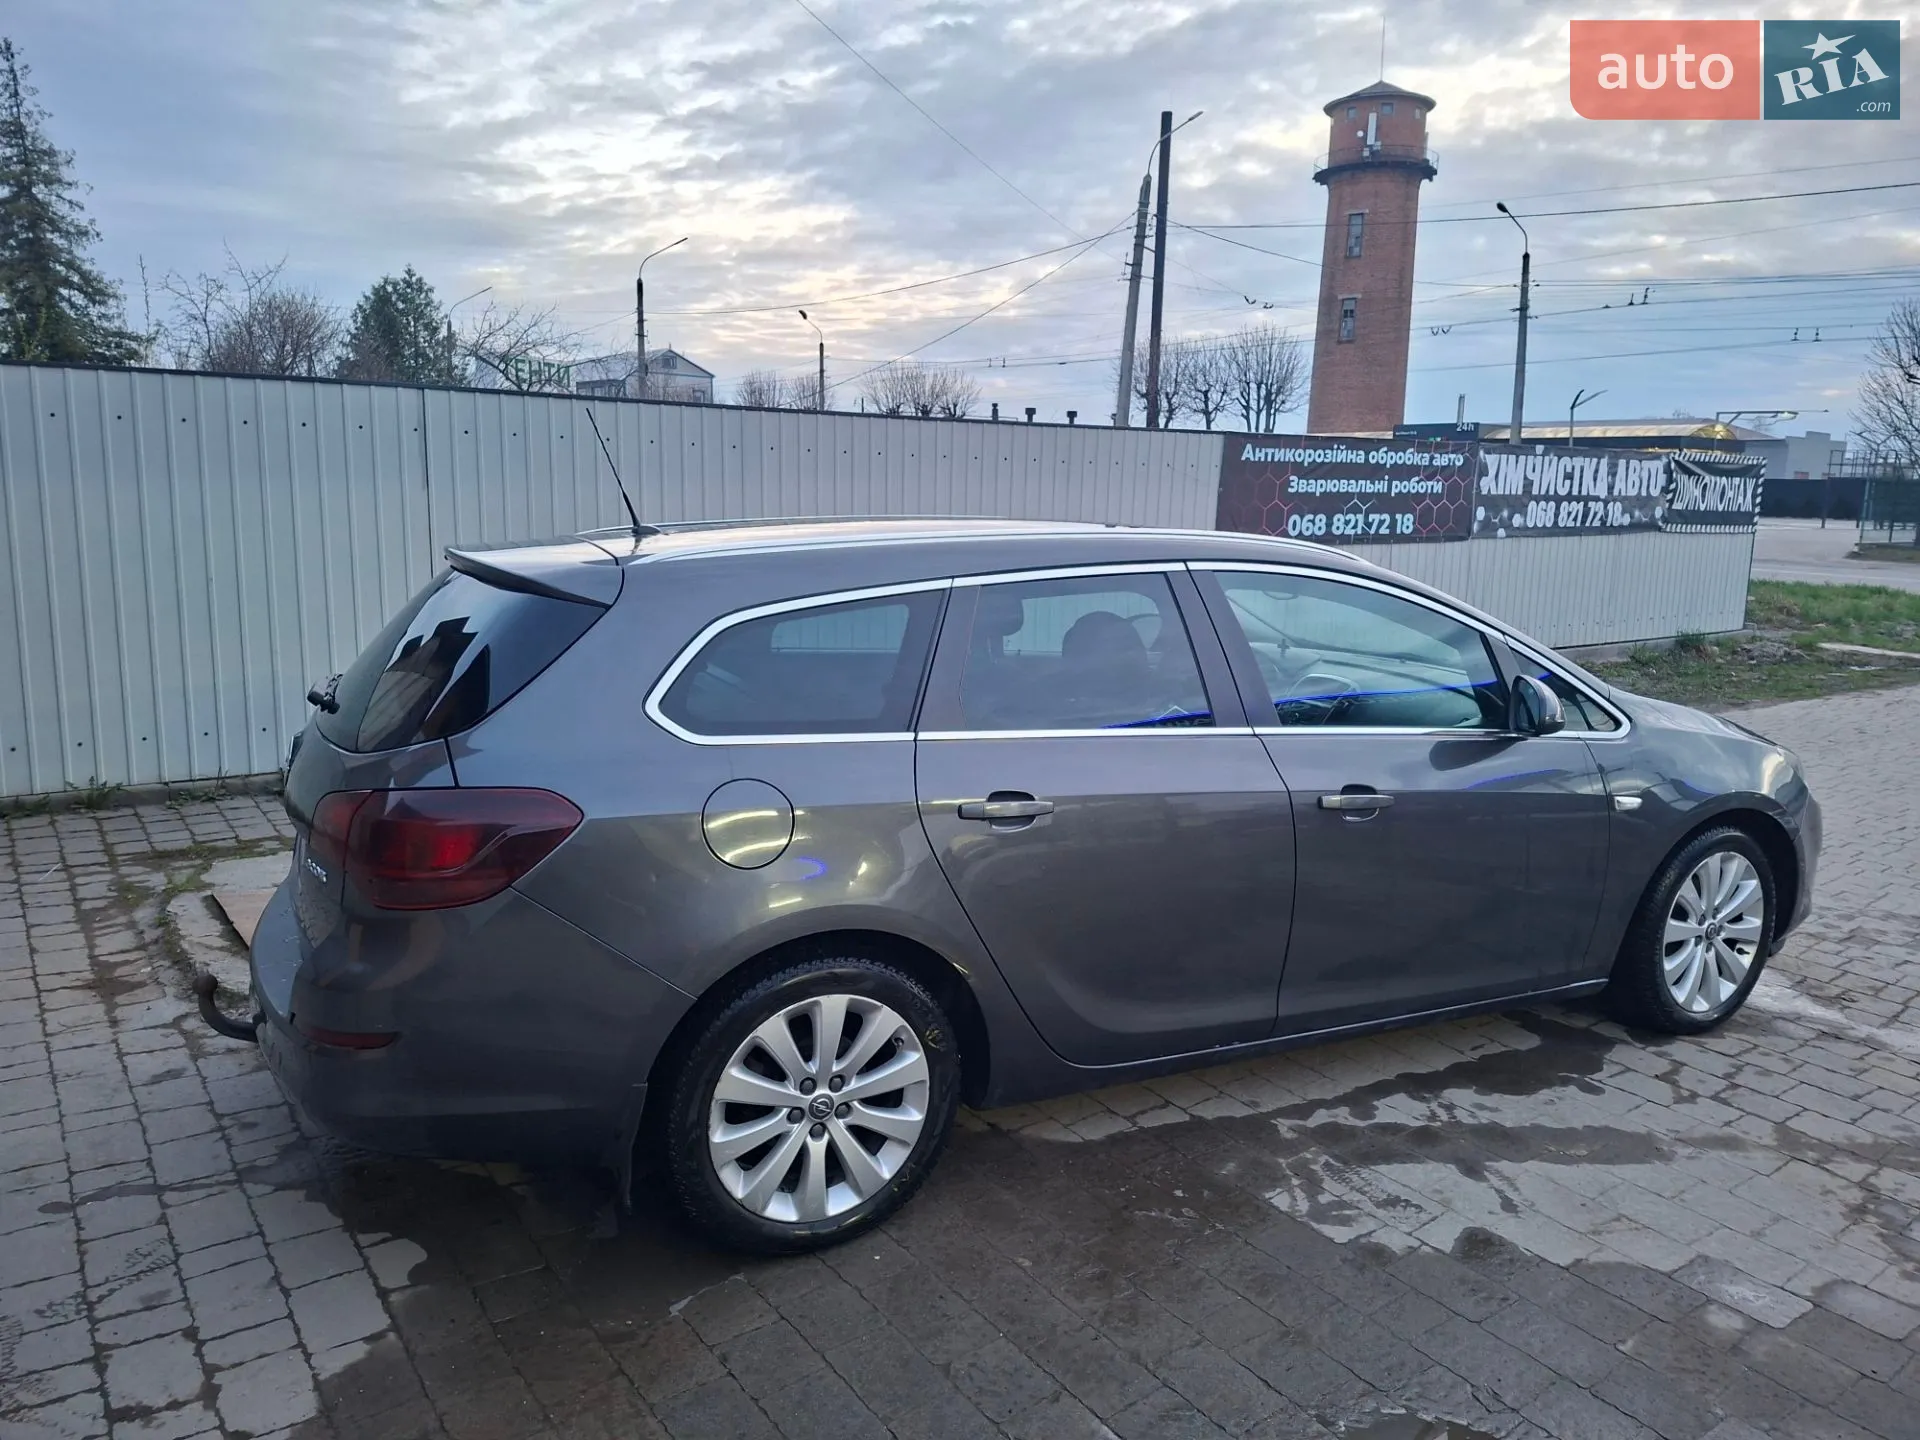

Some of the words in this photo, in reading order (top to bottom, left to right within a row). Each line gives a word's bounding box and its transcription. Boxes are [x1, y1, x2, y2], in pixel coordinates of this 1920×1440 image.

[1241, 443, 1365, 466] Антикорозійна
[1368, 448, 1430, 469] обробка
[1432, 452, 1464, 467] авто
[1287, 475, 1388, 497] Зварювальні
[1391, 478, 1443, 497] роботи
[1481, 453, 1609, 498] ХІМЧИСТКА
[1613, 459, 1665, 497] АВТО
[1675, 475, 1757, 513] ШИНОМОНТАЖ
[1287, 513, 1327, 537] 068
[1331, 513, 1363, 536] 821
[1368, 513, 1391, 535] 72
[1395, 513, 1414, 535] 18
[1526, 500, 1556, 528] 068
[1557, 501, 1584, 528] 821
[1585, 501, 1604, 527] 72
[1606, 501, 1623, 527] 18
